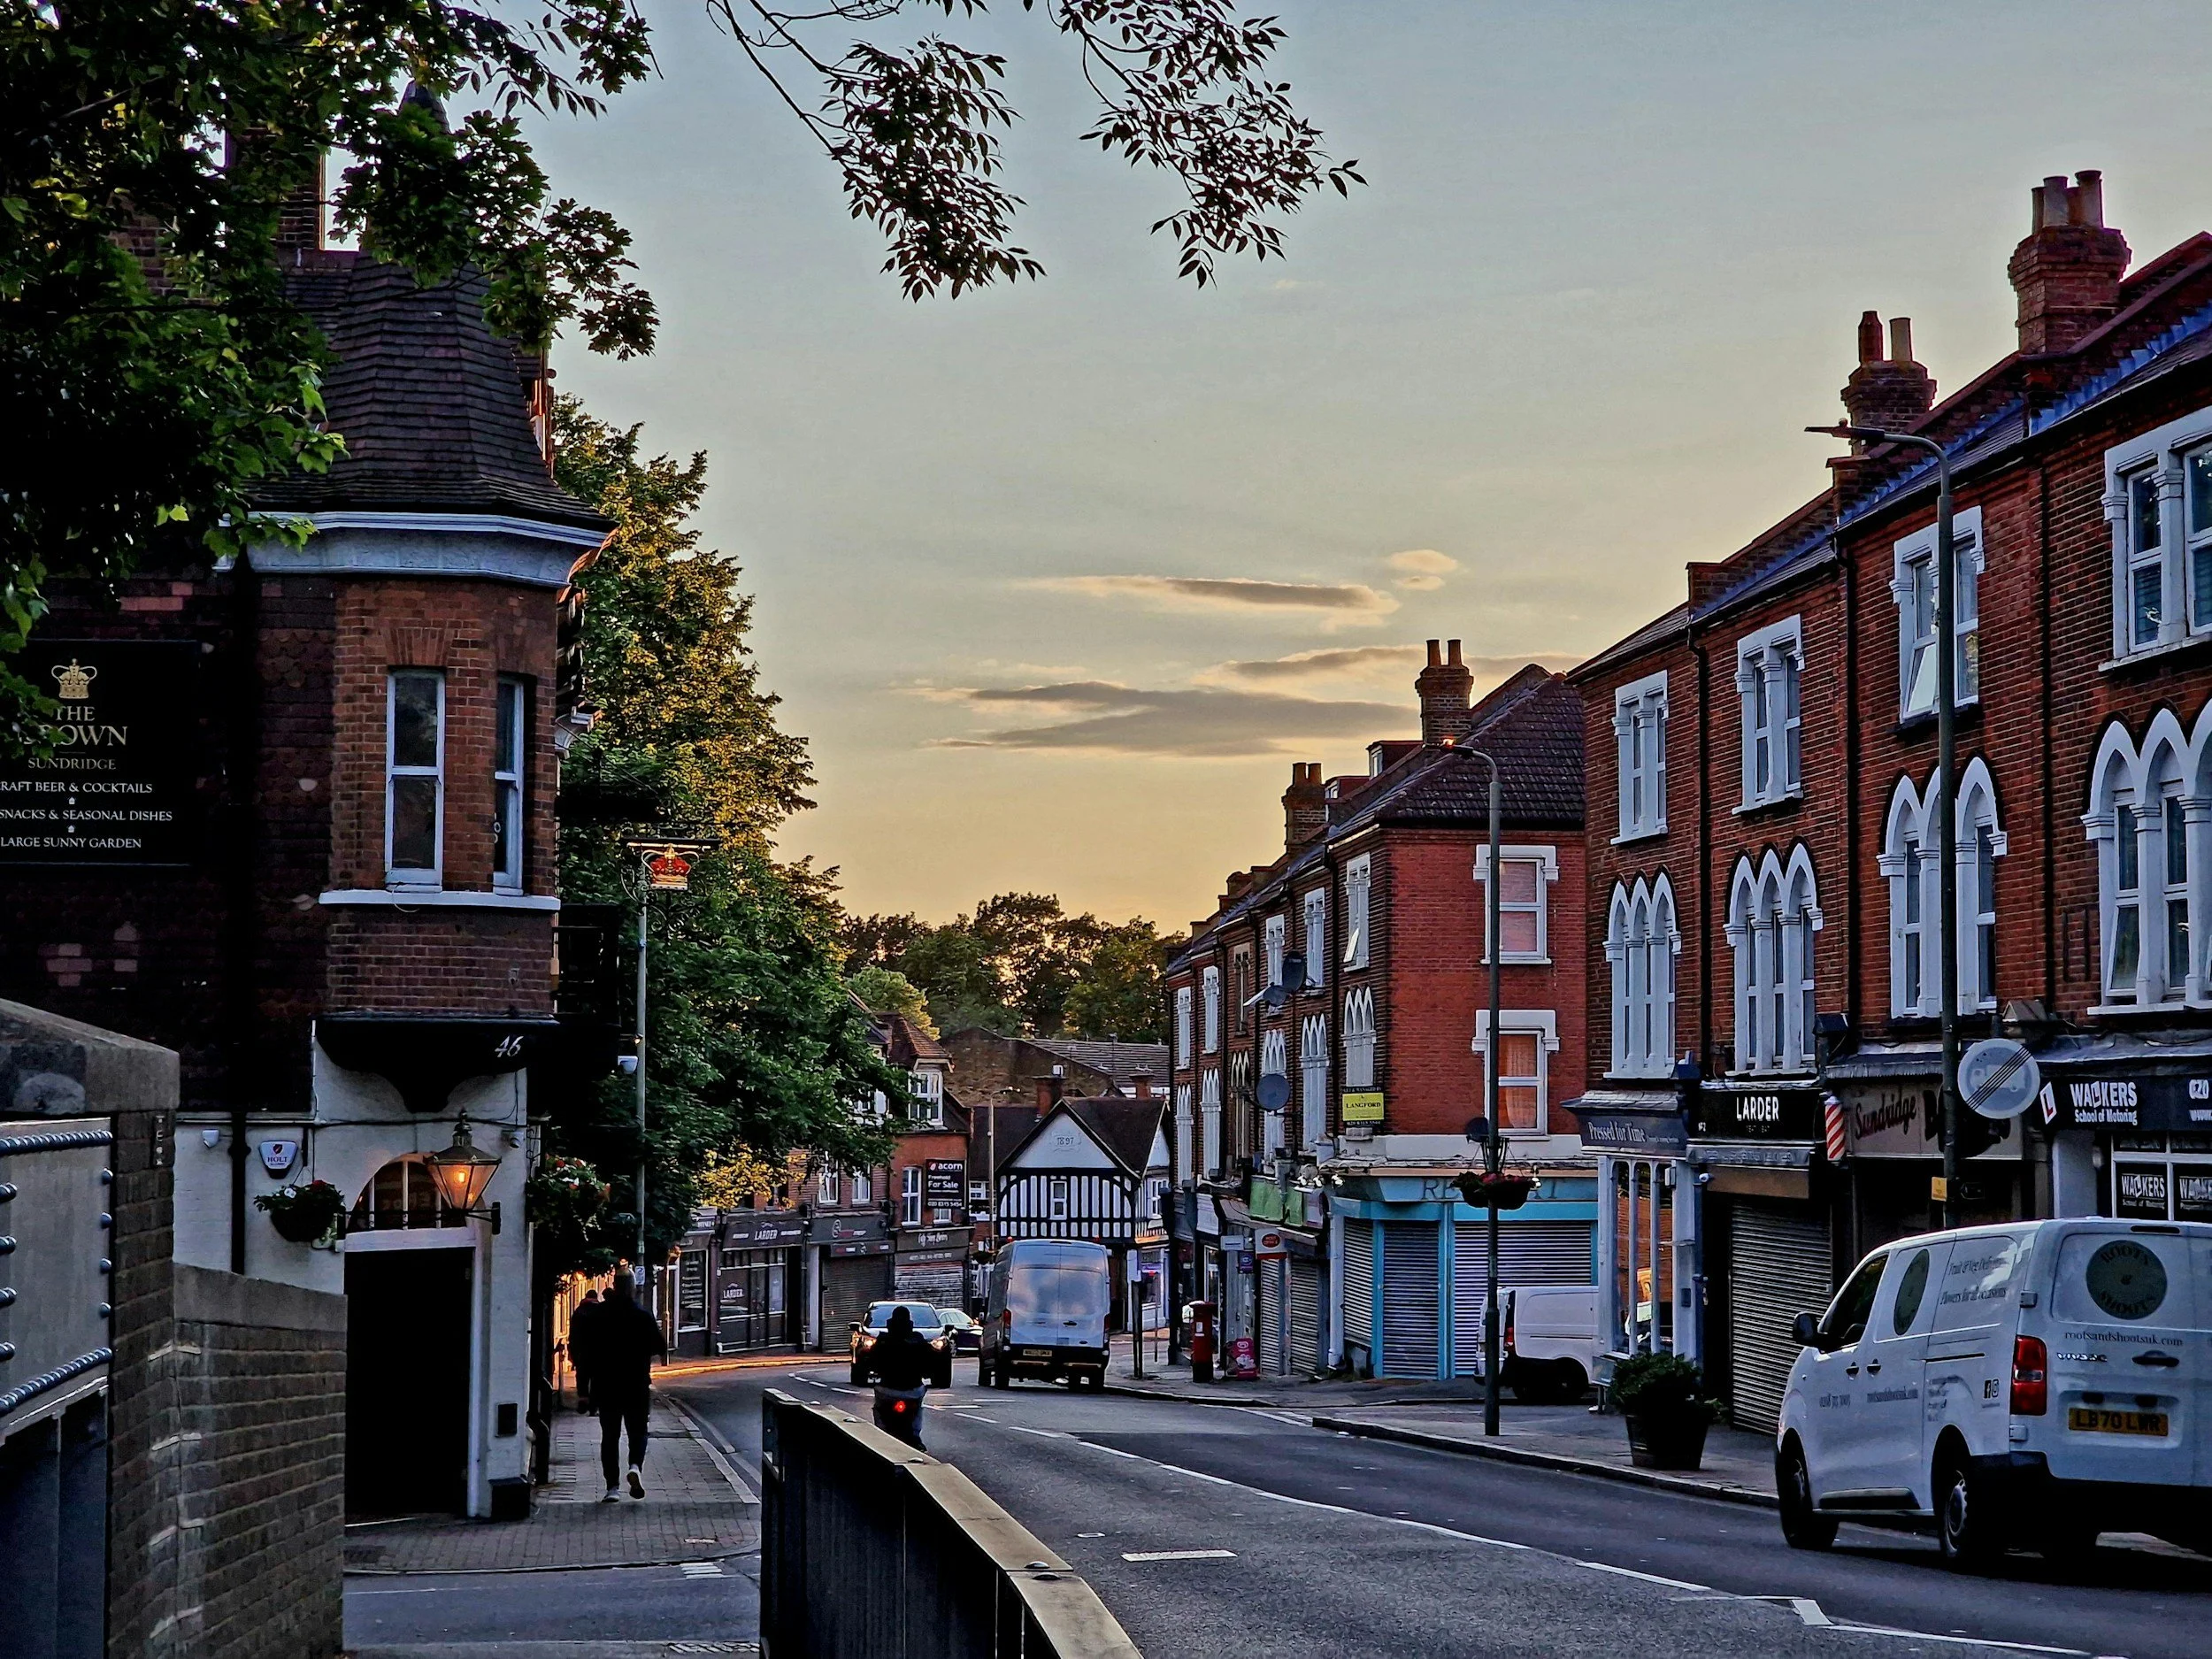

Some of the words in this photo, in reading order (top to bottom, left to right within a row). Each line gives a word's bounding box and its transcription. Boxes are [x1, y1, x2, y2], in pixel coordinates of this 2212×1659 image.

[27, 757, 116, 770] SUNDRIDGE
[0, 781, 33, 792] RAFT
[35, 781, 65, 792] BEER
[68, 782, 80, 792] &
[82, 782, 153, 793] COCKTAILS
[0, 809, 46, 819] SNACKS
[49, 810, 59, 819] &
[63, 810, 127, 820] SEASONAL
[129, 810, 173, 821] DISHES
[0, 836, 41, 847] LARGE
[42, 837, 87, 848] SUNNY
[89, 837, 142, 849] GARDEN
[494, 1035, 525, 1058] 46
[2070, 1081, 2138, 1109] WALKERS
[1736, 1096, 1779, 1121] LARDER
[2074, 1109, 2098, 1123] School
[2098, 1109, 2105, 1122] of
[2106, 1109, 2138, 1125] Motoring
[1587, 1121, 1616, 1141] Pressed
[1615, 1121, 1627, 1141] for
[1625, 1122, 1646, 1142] Time
[2122, 1174, 2165, 1198] WALKERS
[755, 1228, 779, 1240] LARDER
[723, 1288, 743, 1299] LARDER
[2065, 1331, 2184, 1347] rootsandshootsuk.com
